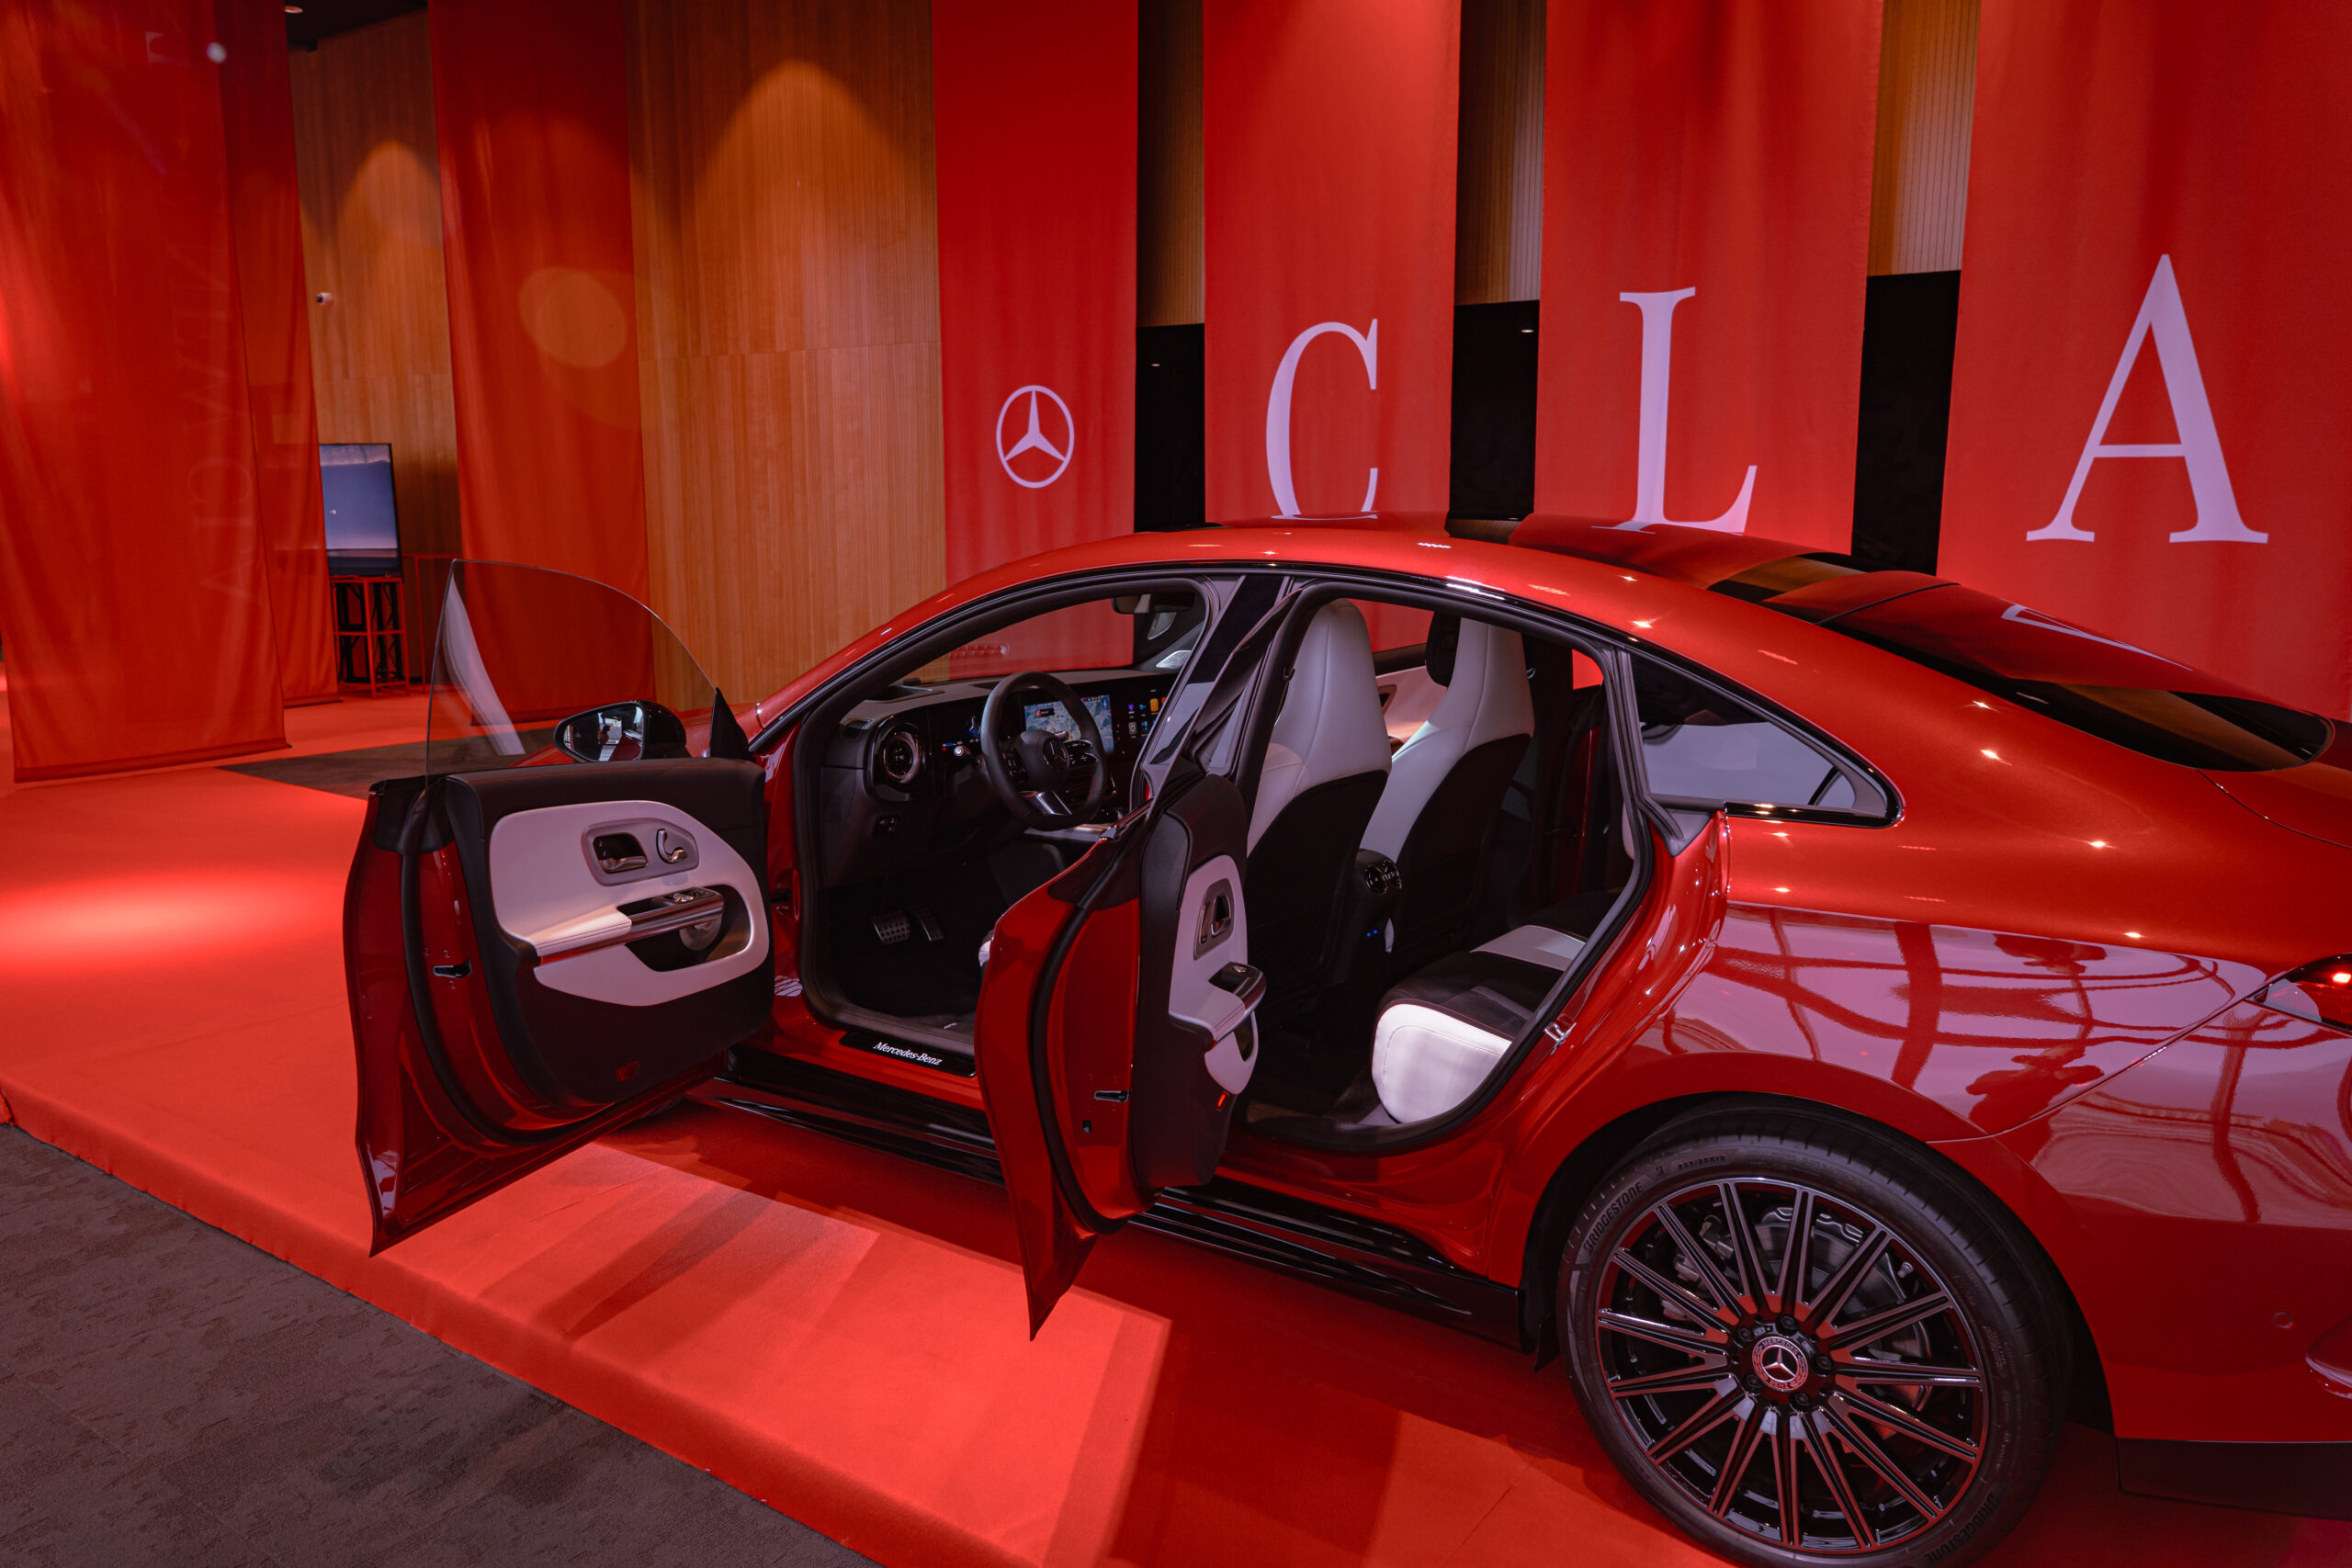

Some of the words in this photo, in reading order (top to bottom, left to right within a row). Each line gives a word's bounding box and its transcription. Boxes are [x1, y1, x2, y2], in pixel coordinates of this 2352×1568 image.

[873, 1042, 943, 1066] Mercedes-Benz
[1583, 1181, 1644, 1255] BRIDGESTONE
[1924, 1492, 2001, 1564] BRIDGESTONE
